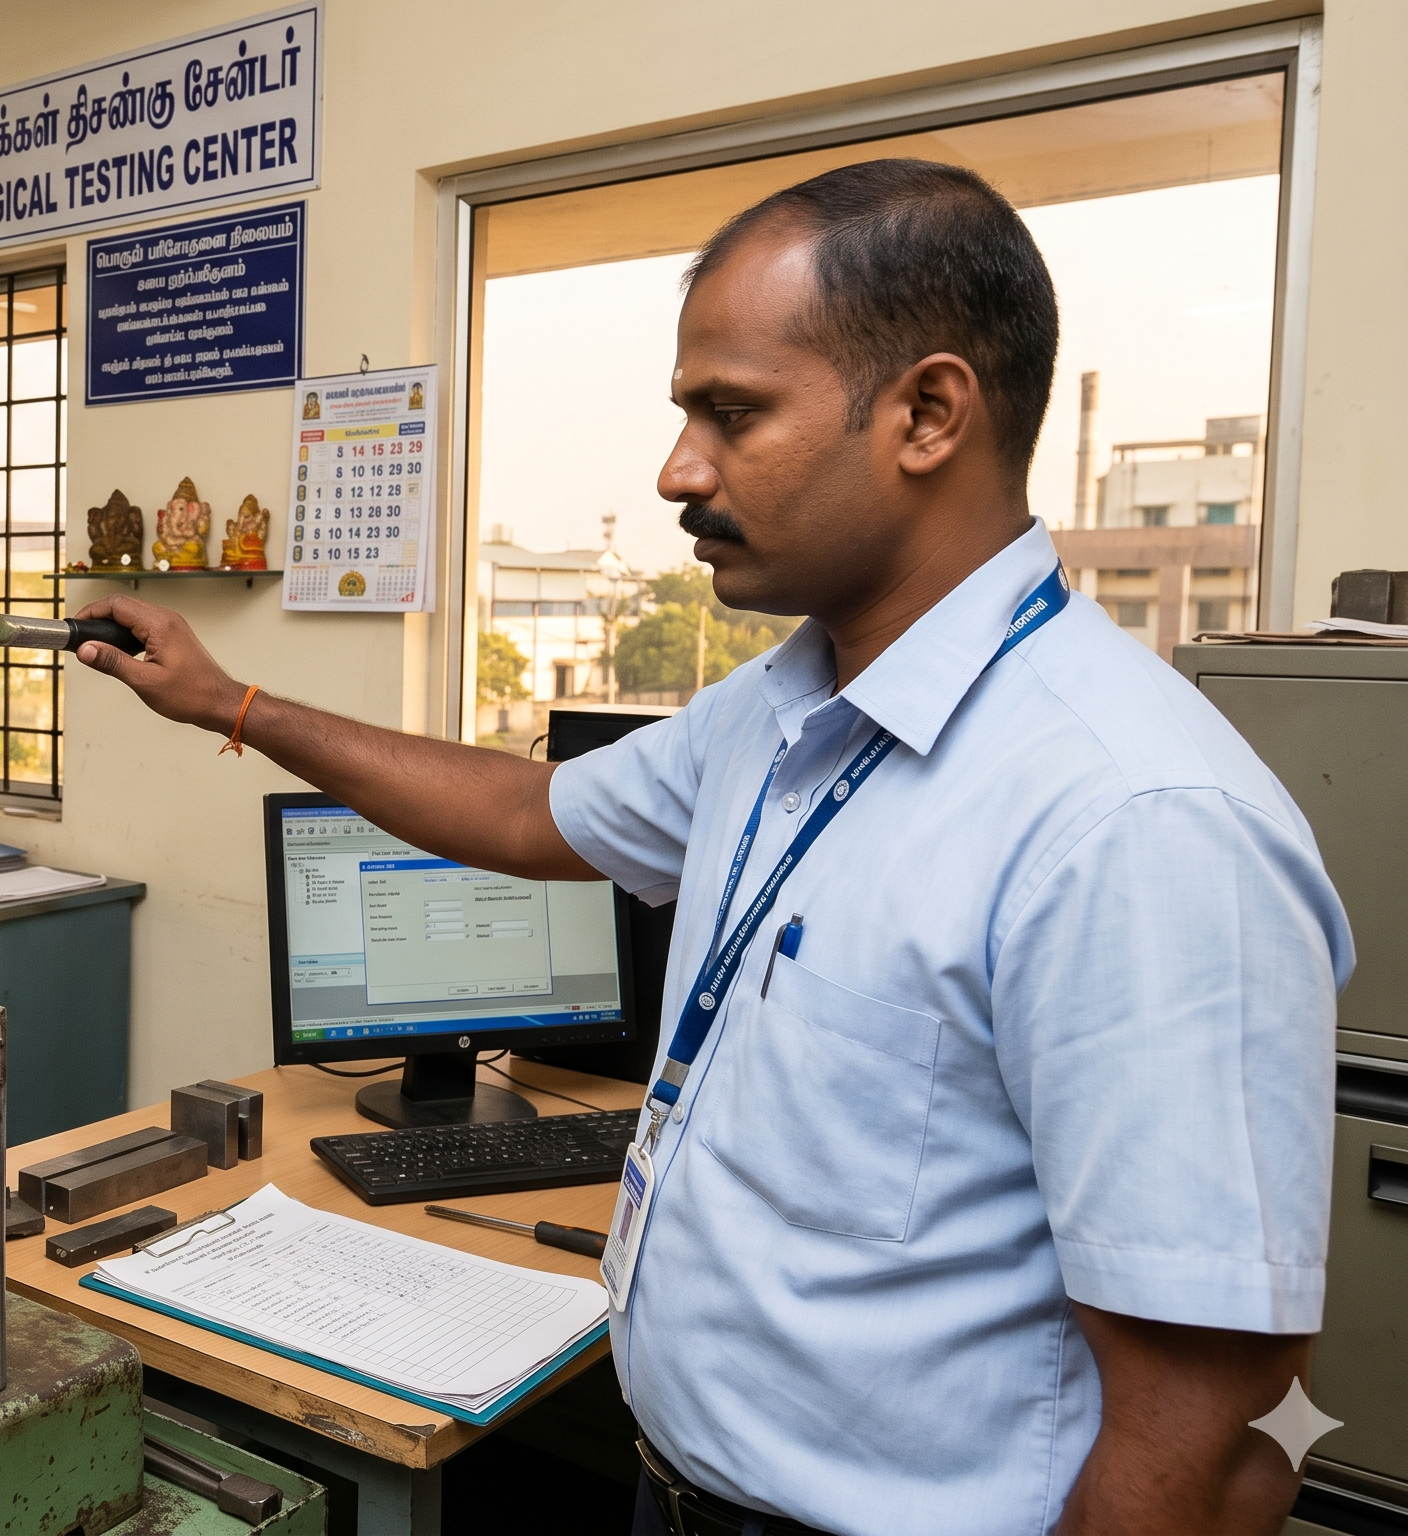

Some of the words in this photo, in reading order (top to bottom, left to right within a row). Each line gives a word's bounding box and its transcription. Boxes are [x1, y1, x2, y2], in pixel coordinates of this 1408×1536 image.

[65, 145, 174, 209] TESTING
[184, 117, 298, 186] CENTER
[352, 445, 365, 457] 14
[372, 444, 384, 456] 15
[390, 442, 403, 454] 23
[408, 440, 422, 453] 29
[351, 465, 365, 478] 10
[371, 464, 383, 476] 16
[389, 463, 402, 475] 29
[407, 462, 421, 474] 30
[316, 487, 321, 498] 1
[335, 487, 342, 498] 8
[351, 486, 363, 498] 12
[370, 485, 382, 497] 12
[315, 508, 321, 519] 2
[334, 507, 341, 519] 9
[350, 506, 362, 518] 13
[368, 506, 381, 518] 28
[387, 505, 401, 517] 30
[329, 527, 342, 539] 10
[348, 527, 361, 539] 14
[367, 526, 380, 538] 23
[386, 526, 400, 538] 30
[312, 549, 319, 560] 5
[328, 548, 341, 560] 10
[347, 548, 359, 559] 15
[366, 547, 379, 559] 23
